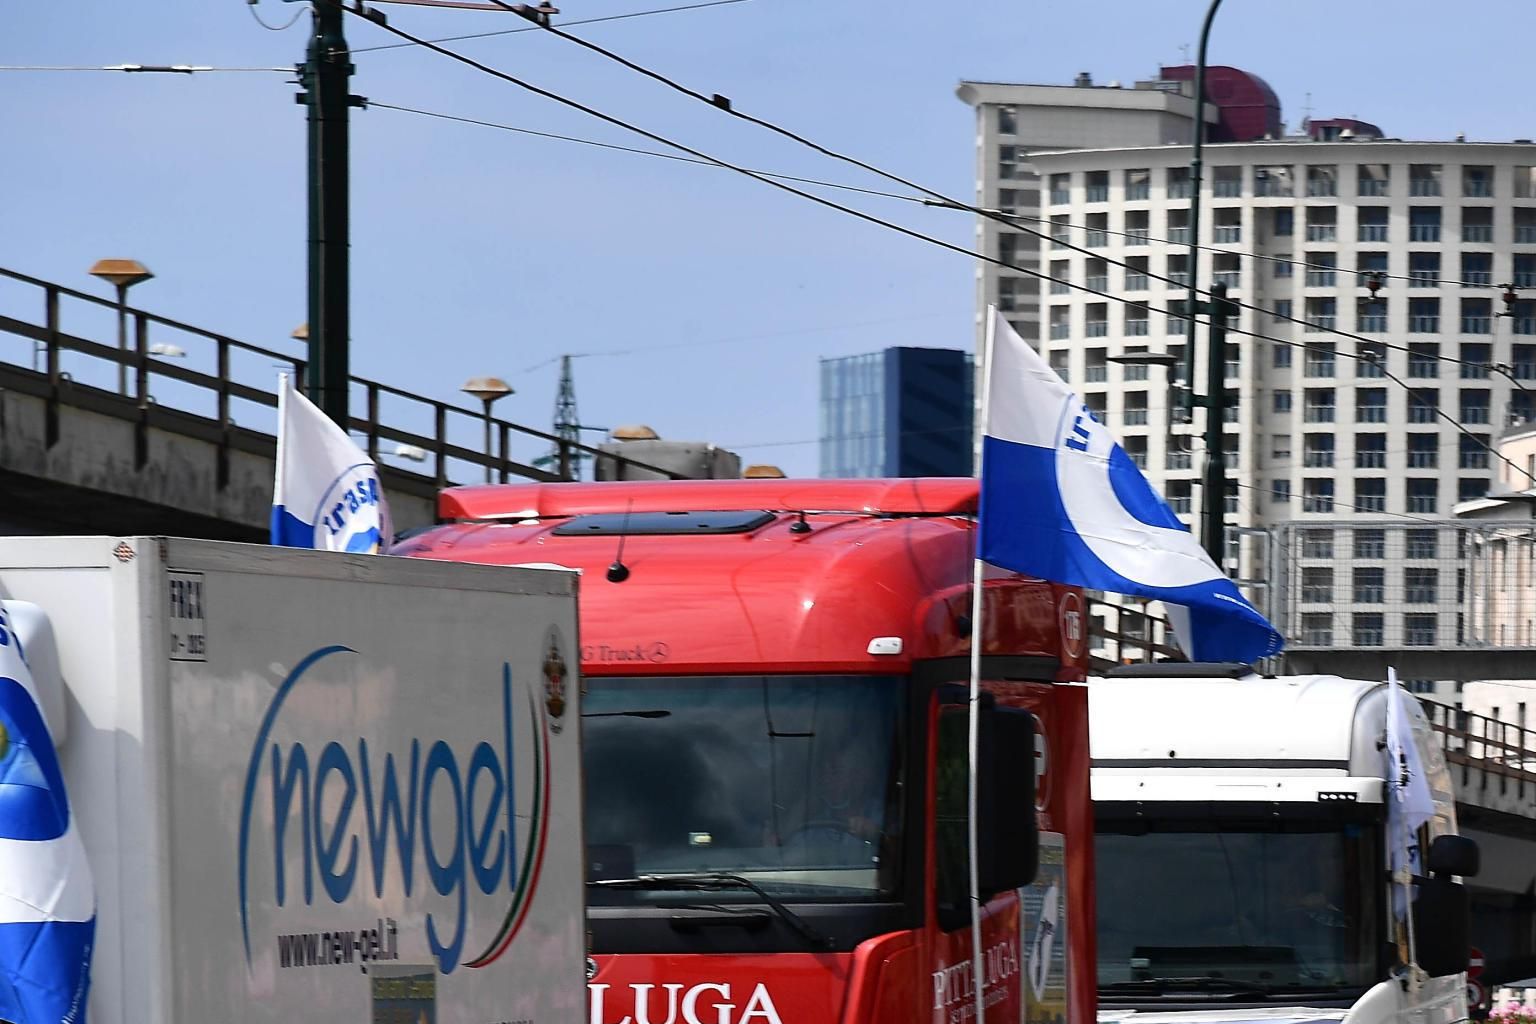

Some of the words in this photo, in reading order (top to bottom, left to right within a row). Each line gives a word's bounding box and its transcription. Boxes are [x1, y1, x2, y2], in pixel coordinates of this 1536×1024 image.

[599, 644, 645, 662] Truck
[271, 660, 518, 975] newgel
[277, 917, 400, 975] www.new-gel.it
